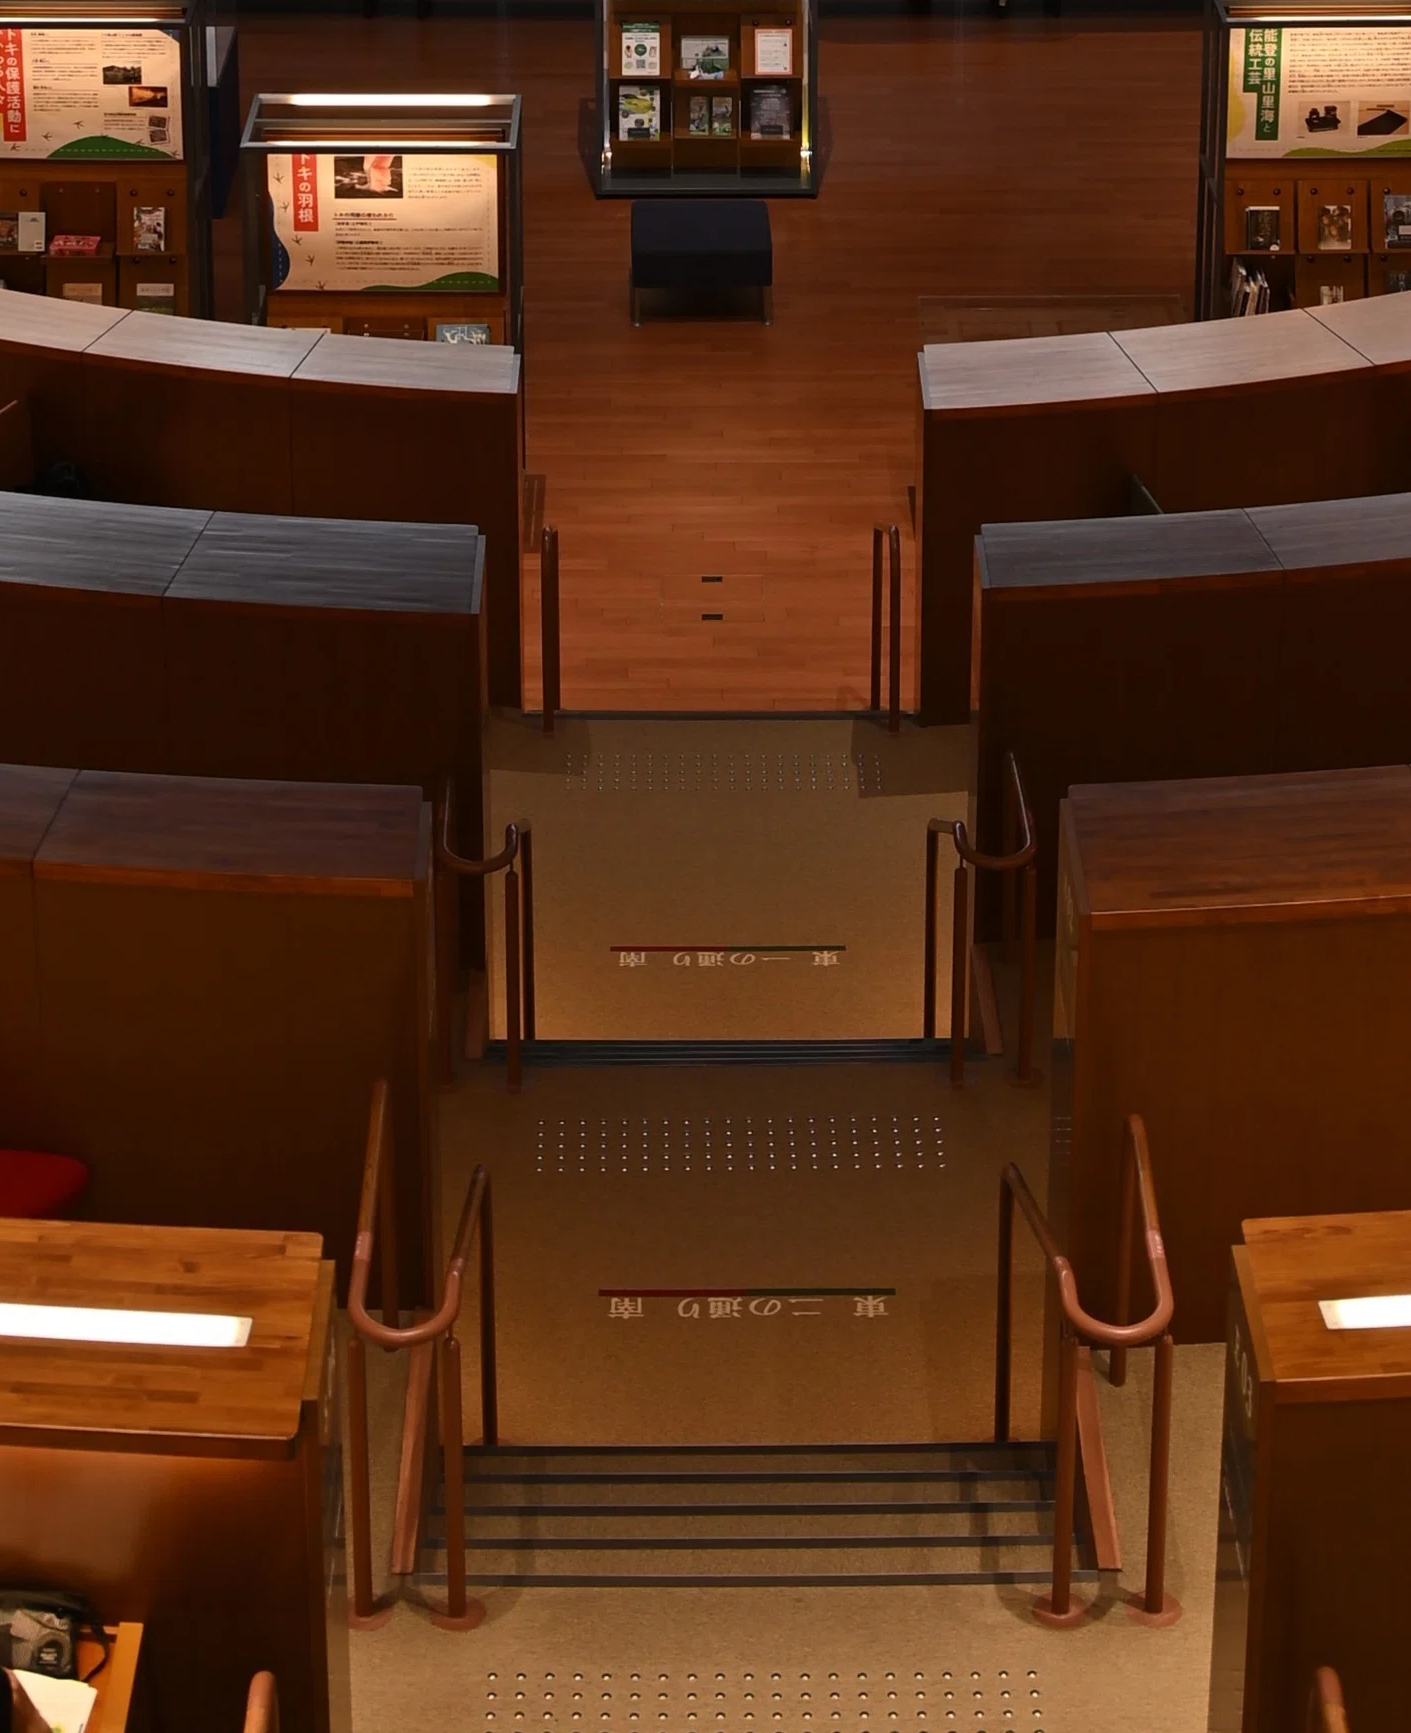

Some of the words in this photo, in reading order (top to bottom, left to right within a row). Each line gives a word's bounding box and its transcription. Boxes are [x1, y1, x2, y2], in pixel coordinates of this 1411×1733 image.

[1247, 28, 1264, 86] 伝統工芸
[1260, 28, 1278, 133] 能登の里山里海と
[296, 153, 314, 223] トキの羽根
[609, 1296, 644, 1319] 南
[677, 1296, 823, 1319] 二の通り
[853, 1295, 889, 1319] 東
